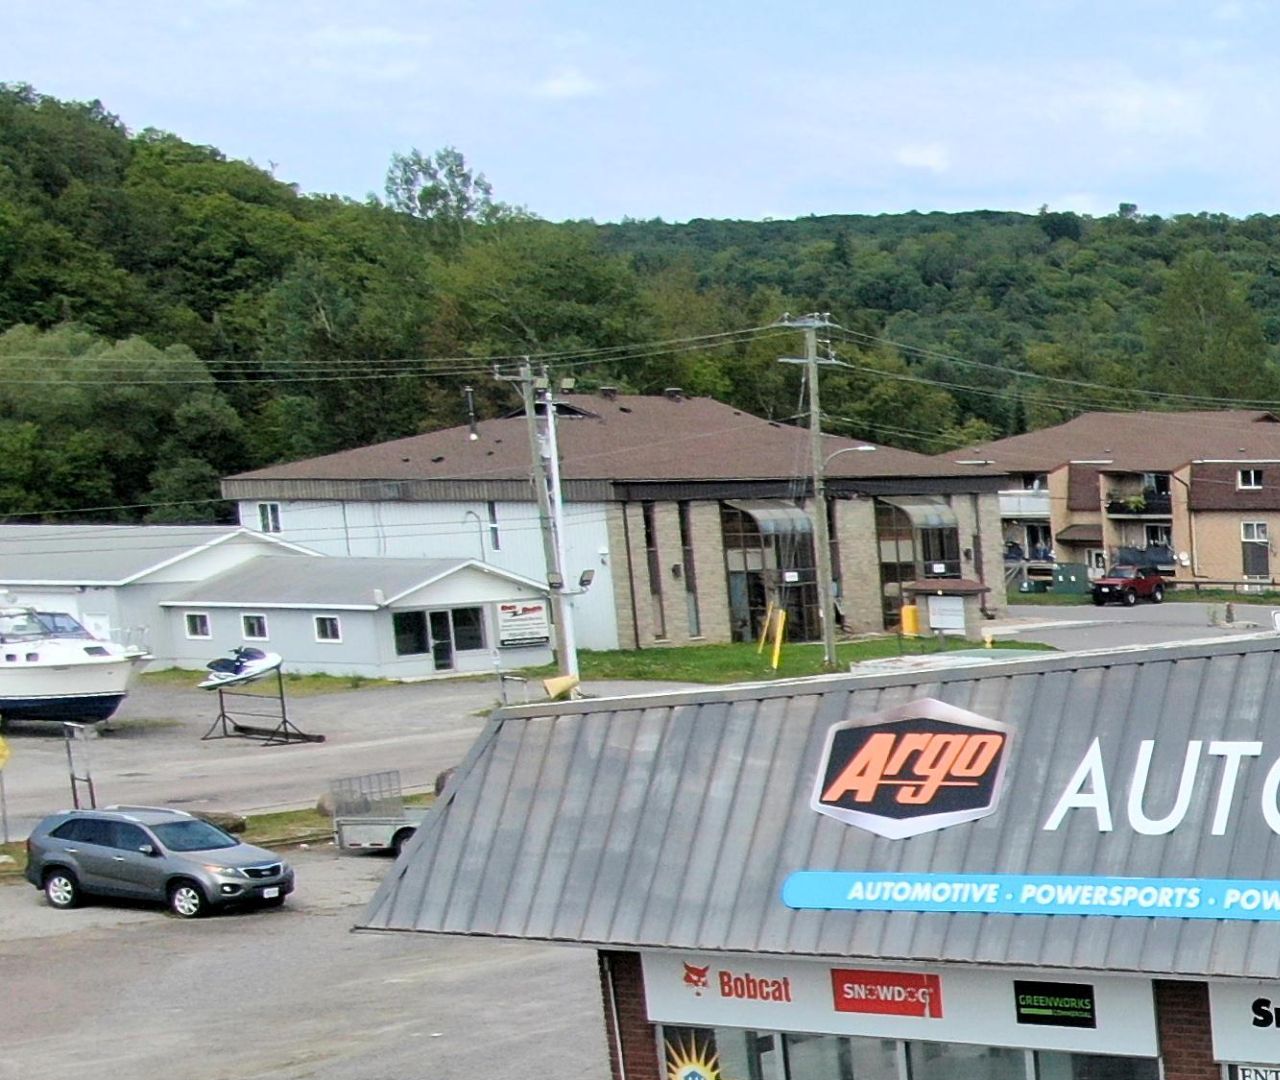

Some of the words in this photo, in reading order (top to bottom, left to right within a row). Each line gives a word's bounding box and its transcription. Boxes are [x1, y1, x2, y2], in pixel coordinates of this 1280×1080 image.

[822, 733, 1003, 804] Argo
[847, 880, 1001, 904] AUTOMOTIVE
[1019, 883, 1202, 909] POWERSPORTS
[719, 970, 791, 1002] Bobcat
[843, 983, 930, 1003] SNOWDOG
[1019, 994, 1091, 1009] GREENWORKS
